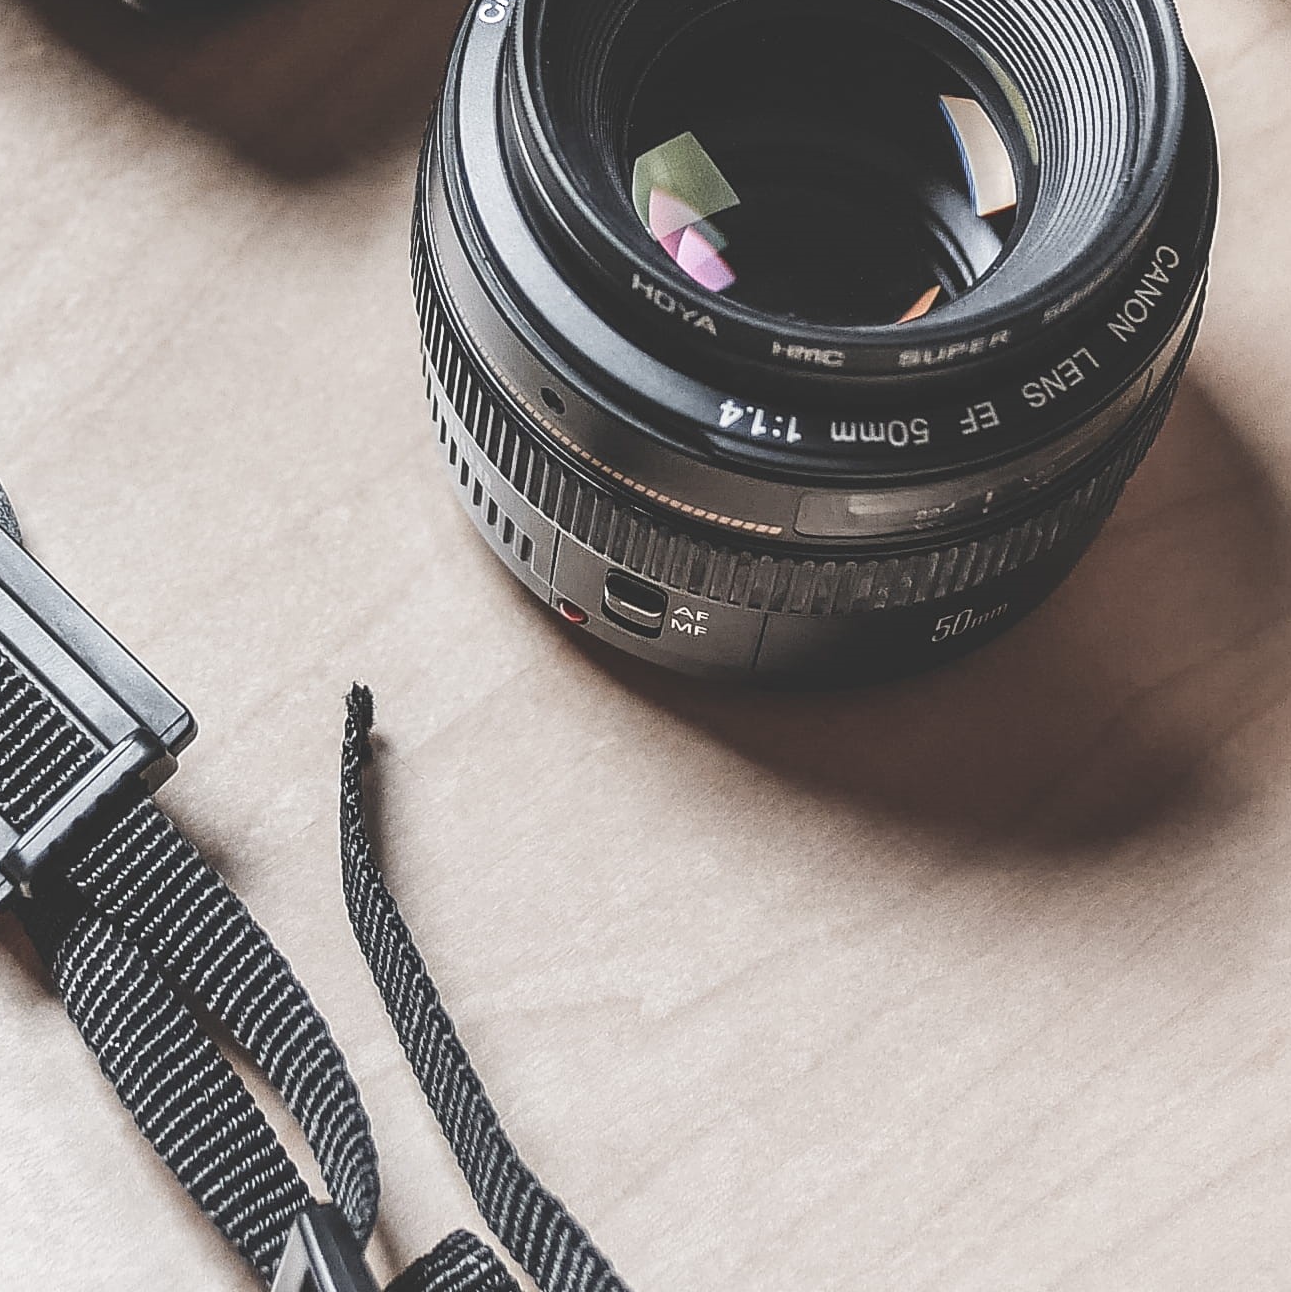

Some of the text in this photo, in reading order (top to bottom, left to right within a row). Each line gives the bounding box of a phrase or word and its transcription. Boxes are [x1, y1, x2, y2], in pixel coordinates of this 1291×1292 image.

[1107, 244, 1181, 343] CANON
[631, 272, 1012, 369] HOYA HMC SUPER
[1021, 346, 1100, 409] LENS
[718, 398, 803, 444] 1:1.4
[830, 416, 931, 448] 50mm
[959, 400, 1001, 436] EF
[670, 618, 708, 637] MF
[673, 606, 710, 622] AF
[930, 603, 1009, 643] 50mm
